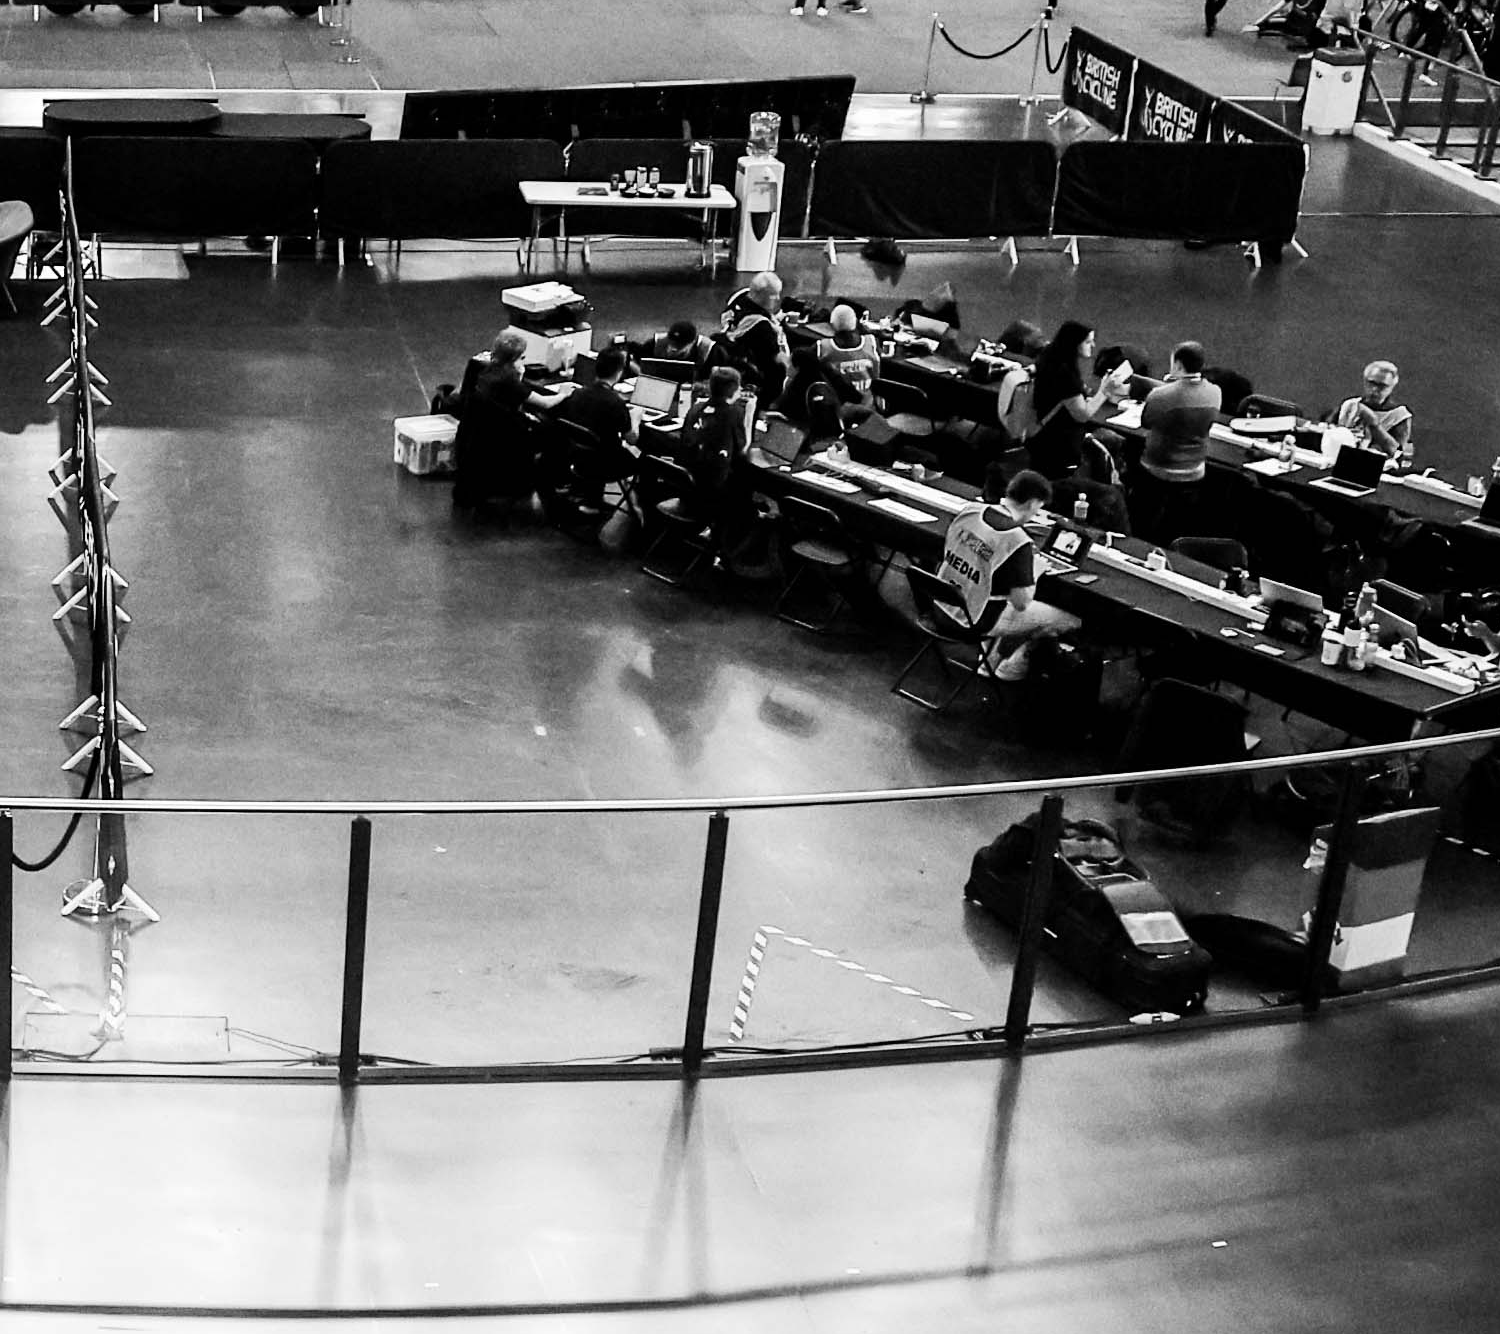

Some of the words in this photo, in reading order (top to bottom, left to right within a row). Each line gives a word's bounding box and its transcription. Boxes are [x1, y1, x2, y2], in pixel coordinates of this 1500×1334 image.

[1084, 52, 1122, 89] BRITISH
[1081, 75, 1118, 110] CYCLING
[1154, 91, 1198, 133] BRITISH
[945, 549, 981, 585] MEDIA
